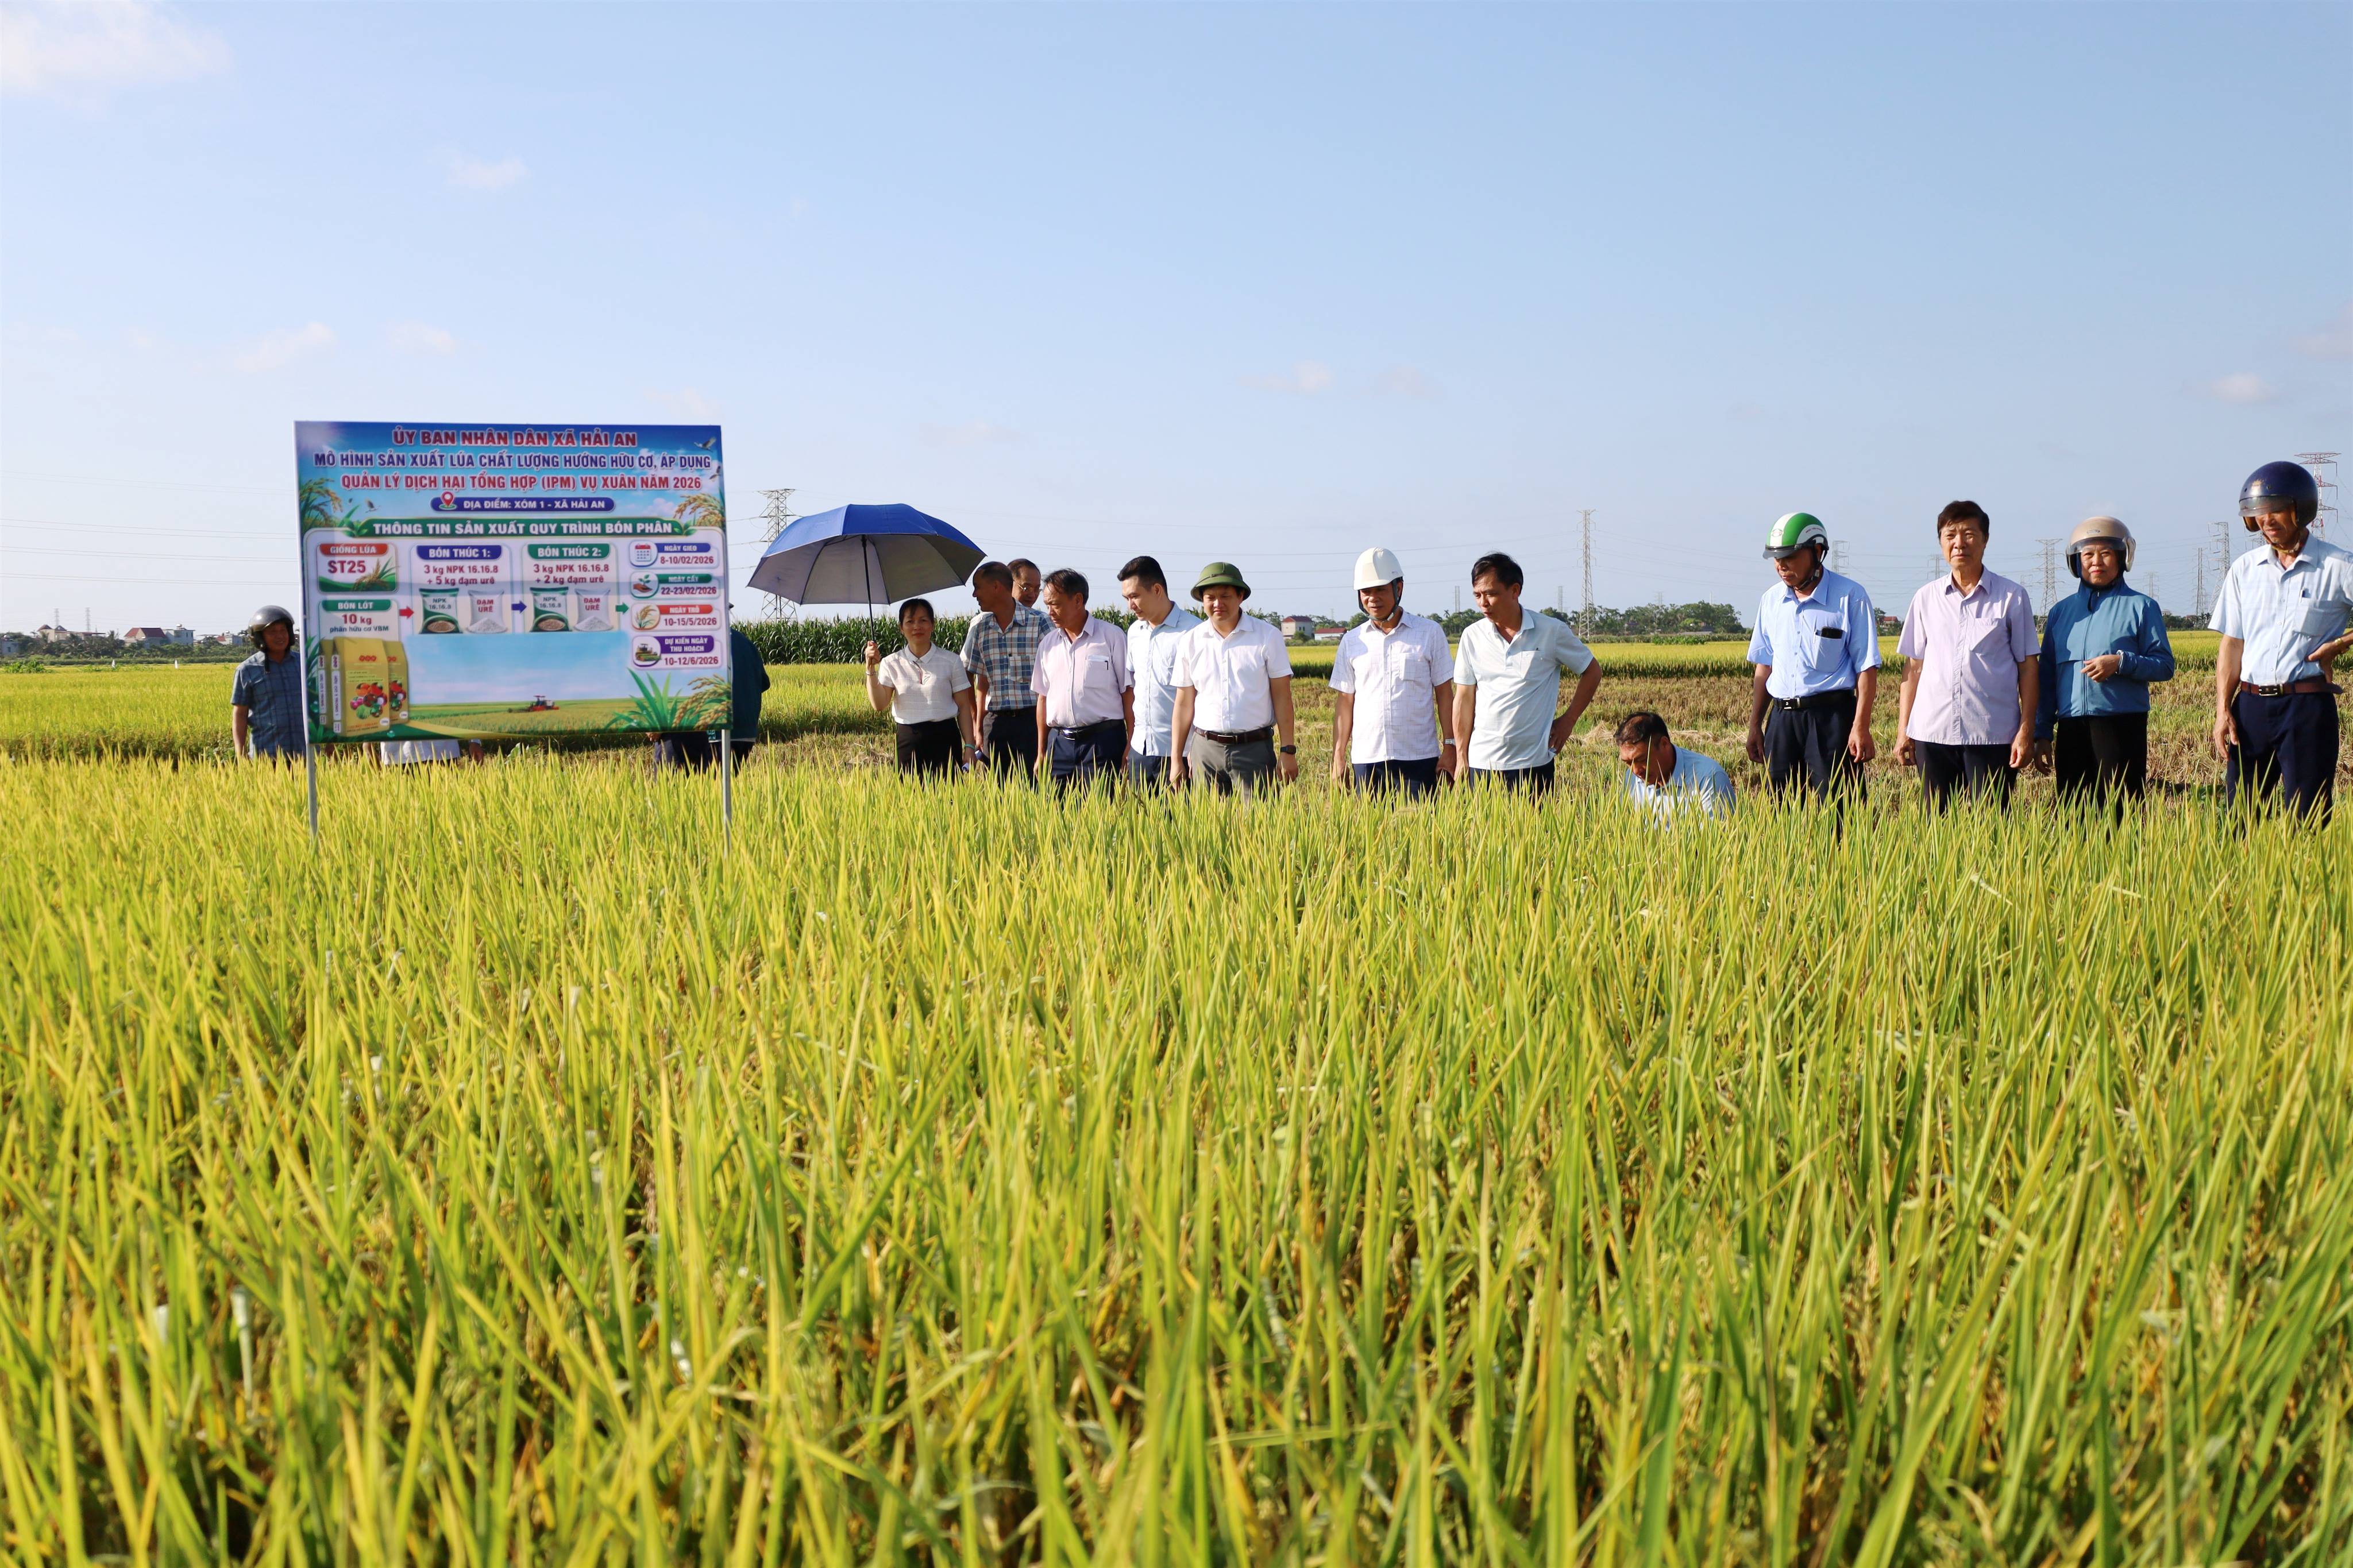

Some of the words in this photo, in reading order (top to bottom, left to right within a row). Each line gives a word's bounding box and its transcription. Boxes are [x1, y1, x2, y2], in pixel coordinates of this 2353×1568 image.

[393, 426, 416, 445] ỦY
[421, 431, 456, 446] BAN
[461, 428, 508, 446] NHÂN
[514, 428, 548, 446] DÂN
[554, 428, 575, 446] XÃ
[581, 427, 608, 447] HẢI
[615, 432, 637, 447] AN
[314, 450, 335, 467] MÔ
[340, 450, 373, 467] HÌNH
[377, 449, 406, 467] SẢN
[410, 449, 445, 467] XUẤT
[449, 450, 473, 468] LÚA
[479, 449, 512, 468] CHẤT
[517, 454, 559, 472] LƯỢNG
[564, 451, 605, 468] HƯỚNG
[610, 451, 634, 468] HỮU
[638, 454, 657, 470] CƠ,
[660, 451, 676, 468] ÁP
[679, 456, 711, 472] DỤNG
[341, 472, 380, 489] QUẢN
[384, 471, 400, 488] LÝ
[404, 474, 437, 492] DỊCH
[442, 474, 464, 492] HẠI
[469, 470, 506, 489] TỔNG
[510, 475, 537, 492] HỢP
[541, 476, 575, 490] (IPM)
[580, 476, 597, 492] VỤ
[601, 473, 636, 489] XUÂN
[641, 472, 669, 489] NĂM
[673, 476, 701, 489] 2026
[464, 500, 481, 511] ĐỊA
[484, 497, 511, 509] ĐIỂM:
[514, 499, 536, 509] XÓM
[555, 499, 568, 509] XÃ
[571, 499, 588, 509] HẢI
[591, 500, 604, 508] AN
[373, 520, 422, 535] THÔNG
[426, 523, 450, 535] TIN
[454, 520, 484, 535] SẢN
[488, 520, 525, 534] XUẤT
[529, 523, 557, 535] QUY
[561, 520, 601, 534] TRÌNH
[605, 520, 634, 534] BÓN
[638, 519, 673, 534] PHÂN
[360, 544, 376, 553] LÚA
[429, 547, 450, 557] BÓN
[453, 547, 479, 557] THÚC
[538, 546, 559, 557] BÓN
[562, 546, 589, 556] THÚC
[661, 556, 713, 564] 8-10/02/2026
[327, 560, 366, 574] ST25
[424, 565, 430, 573] 3
[433, 566, 443, 575] kg
[468, 565, 498, 573] 16.16.8
[534, 564, 540, 573] 3
[542, 565, 553, 574] kg
[578, 564, 609, 572] 16.16.8
[436, 576, 442, 585] 5
[445, 577, 456, 586] kg
[458, 577, 477, 586] đạm
[553, 576, 565, 585] kg
[568, 576, 587, 585] đạm
[661, 586, 716, 595] 22-23/02/2026
[338, 601, 355, 609] BÓN
[358, 600, 373, 609] LÓT
[342, 614, 357, 624] 10
[360, 616, 372, 625] kg
[664, 617, 717, 626] 10-15/5/2026
[665, 656, 718, 666] 10-12/6/2026
